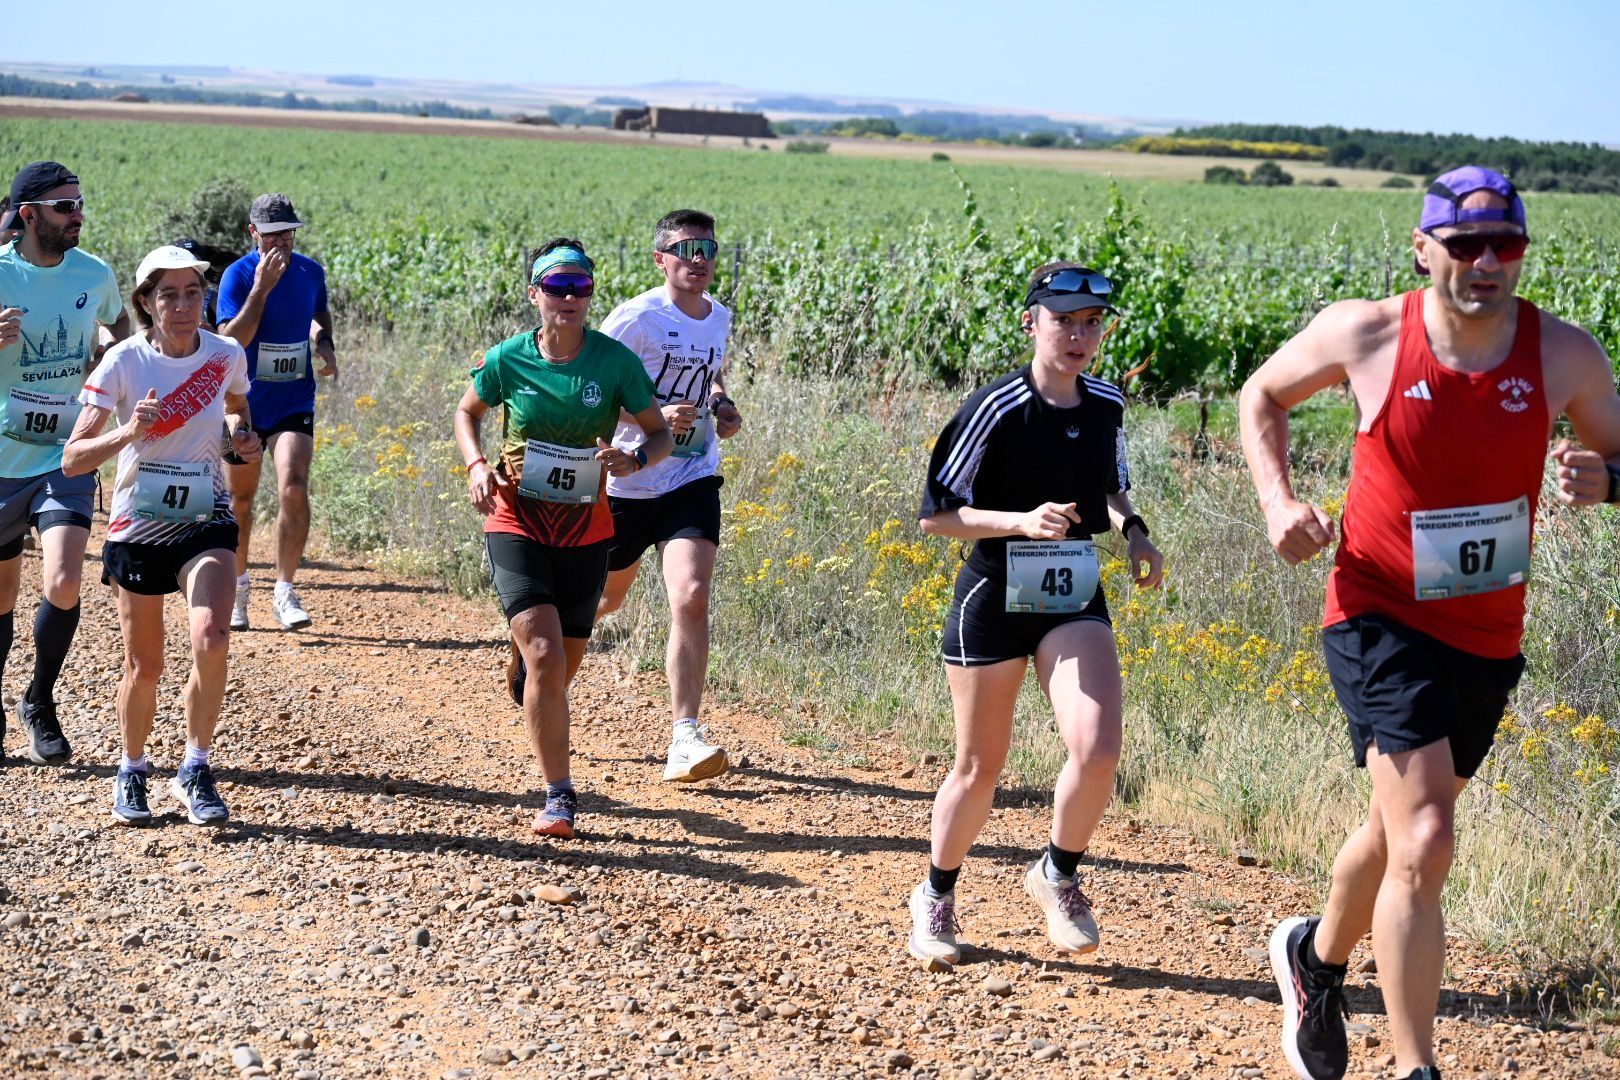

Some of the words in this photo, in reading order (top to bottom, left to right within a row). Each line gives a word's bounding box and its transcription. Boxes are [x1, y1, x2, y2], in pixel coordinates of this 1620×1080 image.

[272, 357, 297, 373] 100
[158, 367, 217, 422] DESPENSA
[179, 403, 195, 420] DE
[24, 411, 59, 434] 194
[527, 446, 557, 458] PEREGRINO
[138, 466, 170, 475] PEREGRINO
[546, 466, 576, 491] 45
[162, 484, 190, 509] 47
[1415, 520, 1464, 531] PEREGRINO
[1465, 514, 1513, 528] ENTRECEPAS
[1009, 550, 1048, 558] PEREGRINO
[1459, 537, 1496, 576] 67
[1040, 567, 1073, 597] 43
